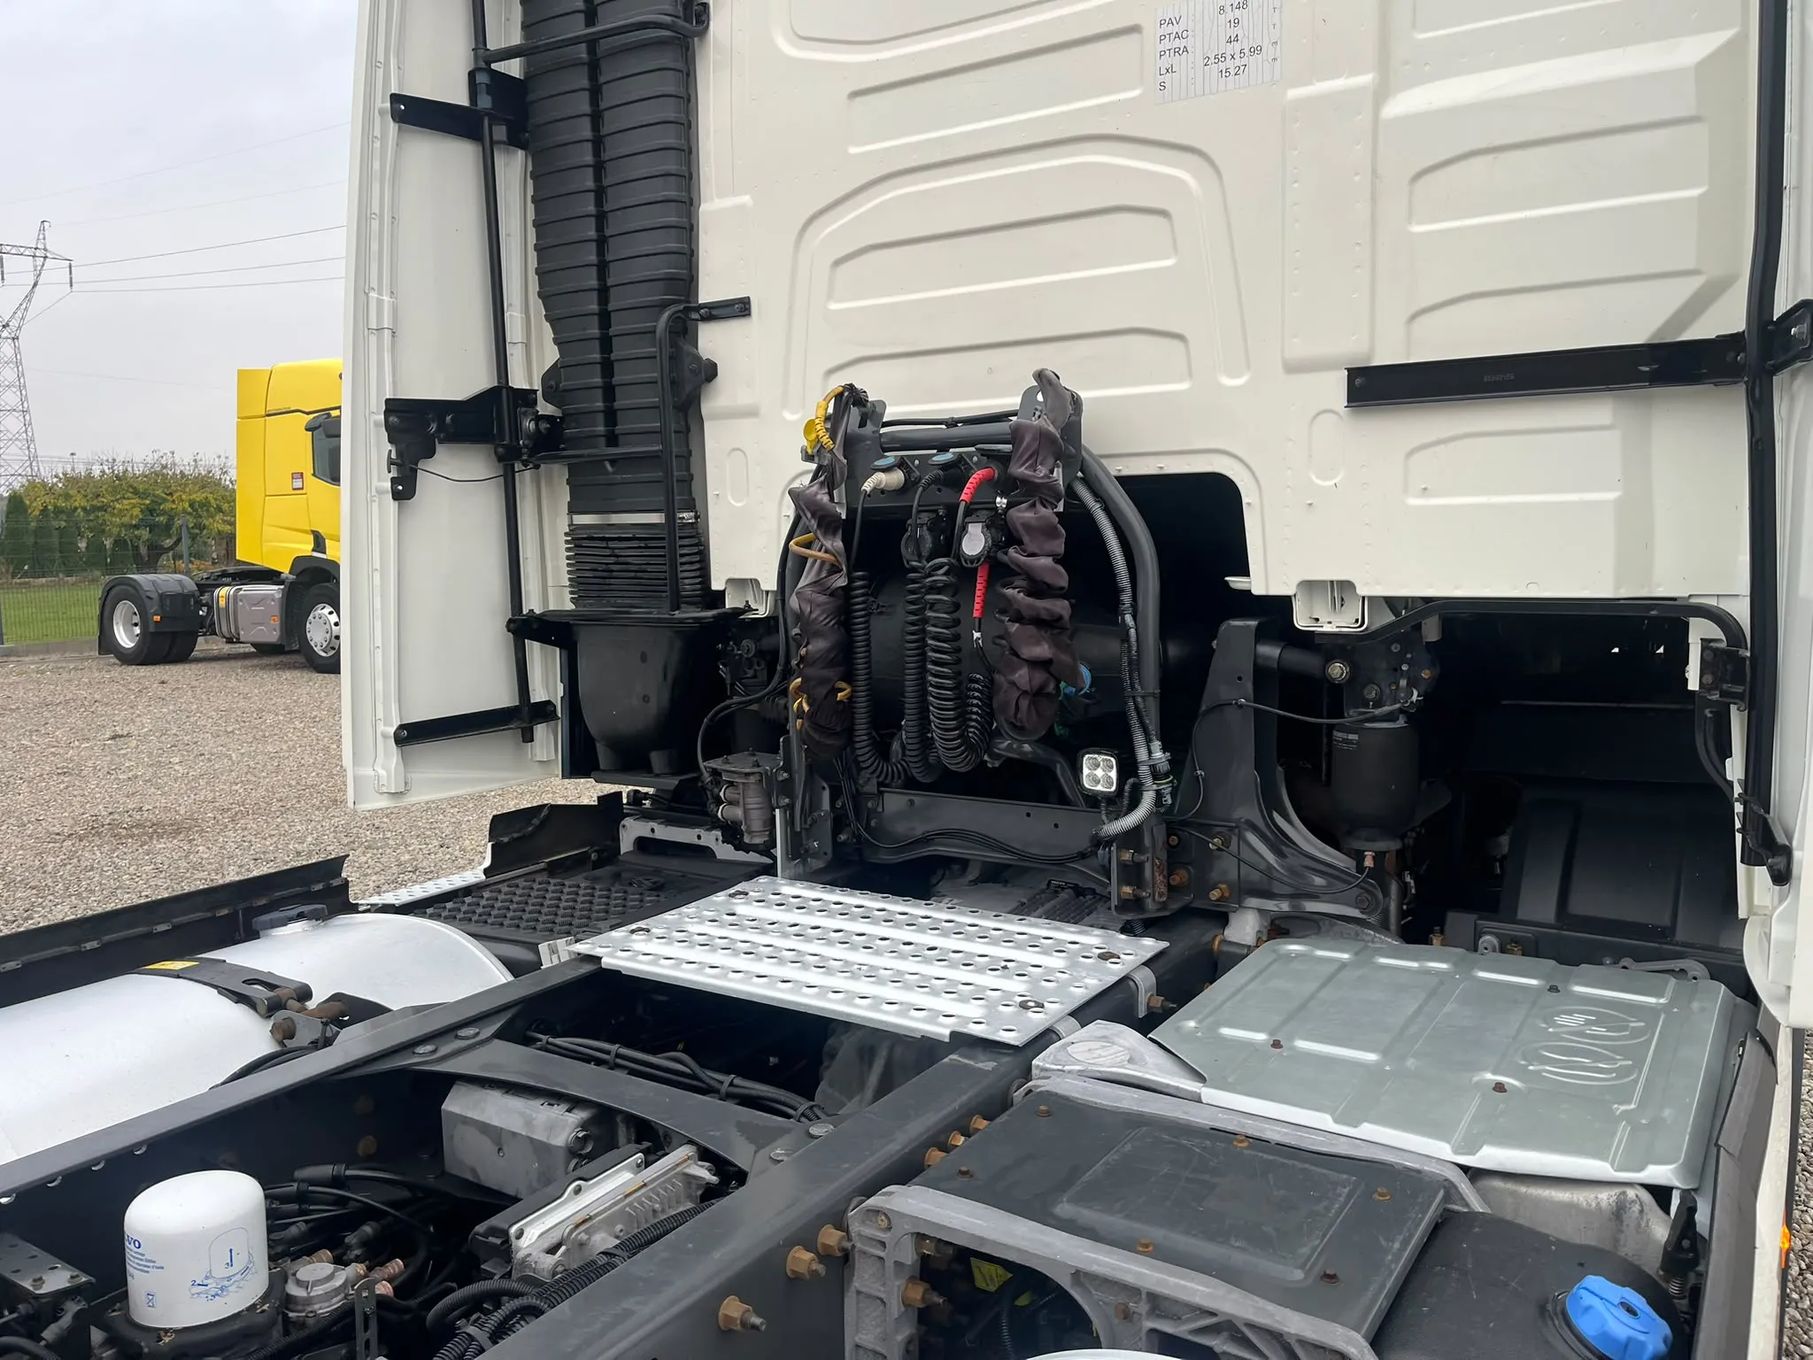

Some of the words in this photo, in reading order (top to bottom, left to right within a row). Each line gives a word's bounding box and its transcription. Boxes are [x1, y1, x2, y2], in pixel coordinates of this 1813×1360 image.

[1159, 15, 1182, 29] PAV
[1159, 29, 1189, 45] PTAC
[1227, 17, 1240, 29] 19
[1158, 63, 1177, 76] LxL
[1203, 52, 1227, 67] 2.55
[1229, 52, 1236, 61] x
[1239, 44, 1263, 60] 5.99
[1159, 45, 1189, 60] PTRA
[1226, 33, 1239, 45] 44
[1158, 81, 1166, 91] S
[1218, 64, 1248, 79] 15.27
